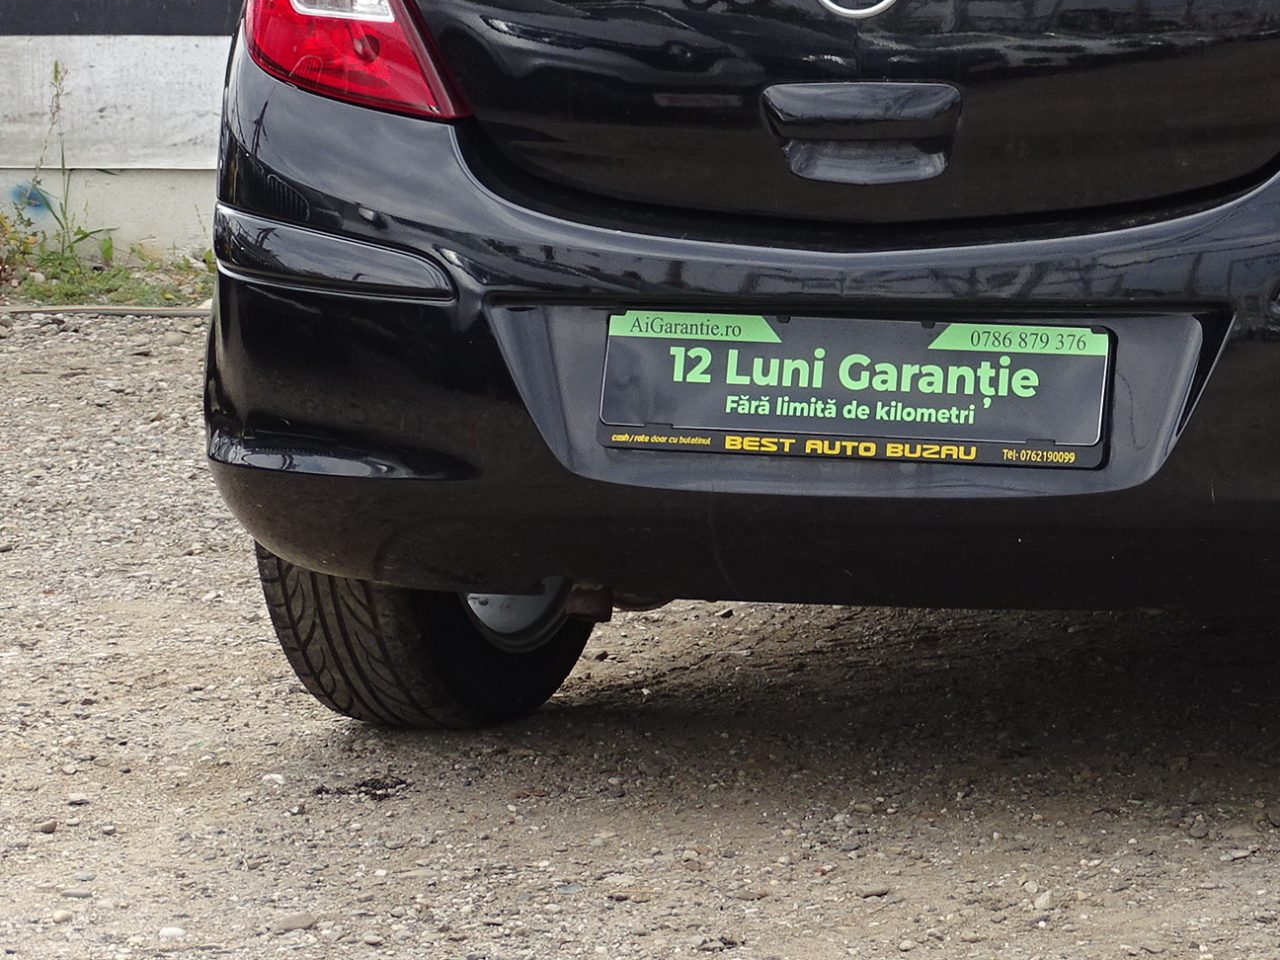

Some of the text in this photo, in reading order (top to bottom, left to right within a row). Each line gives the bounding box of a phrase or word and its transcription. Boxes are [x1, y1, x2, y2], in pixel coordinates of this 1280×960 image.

[630, 316, 742, 338] AiGarantie.ro
[970, 329, 1087, 352] 0786 879 376
[670, 346, 1040, 409] 12 Luni Garanție
[725, 394, 975, 425] Fără limită de kilometri
[724, 434, 796, 452] BEST
[805, 439, 877, 456] AUTO
[886, 442, 977, 460] BUZAU
